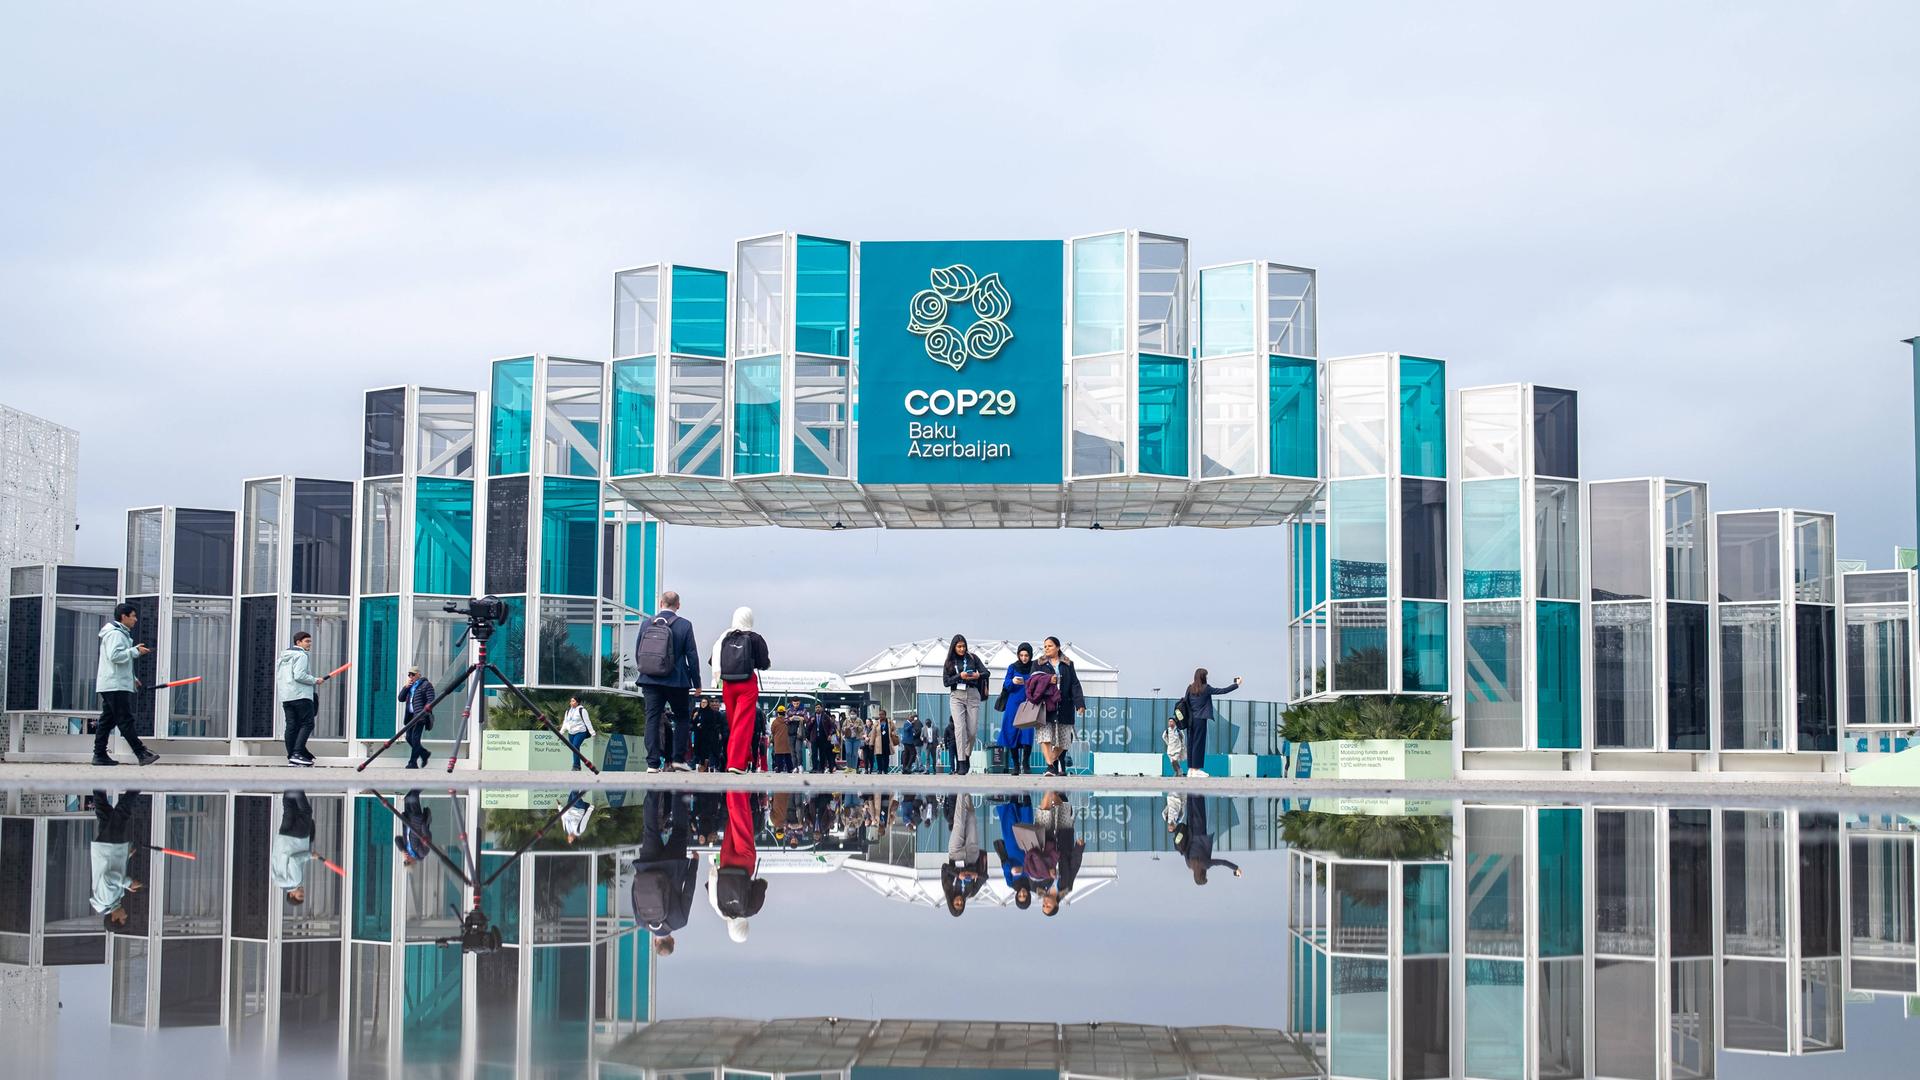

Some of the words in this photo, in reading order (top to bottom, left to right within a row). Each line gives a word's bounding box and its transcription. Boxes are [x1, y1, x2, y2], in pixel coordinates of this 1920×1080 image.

[904, 389, 1016, 416] COP29
[909, 422, 956, 439] Baku
[907, 440, 1011, 461] Azerbaijan
